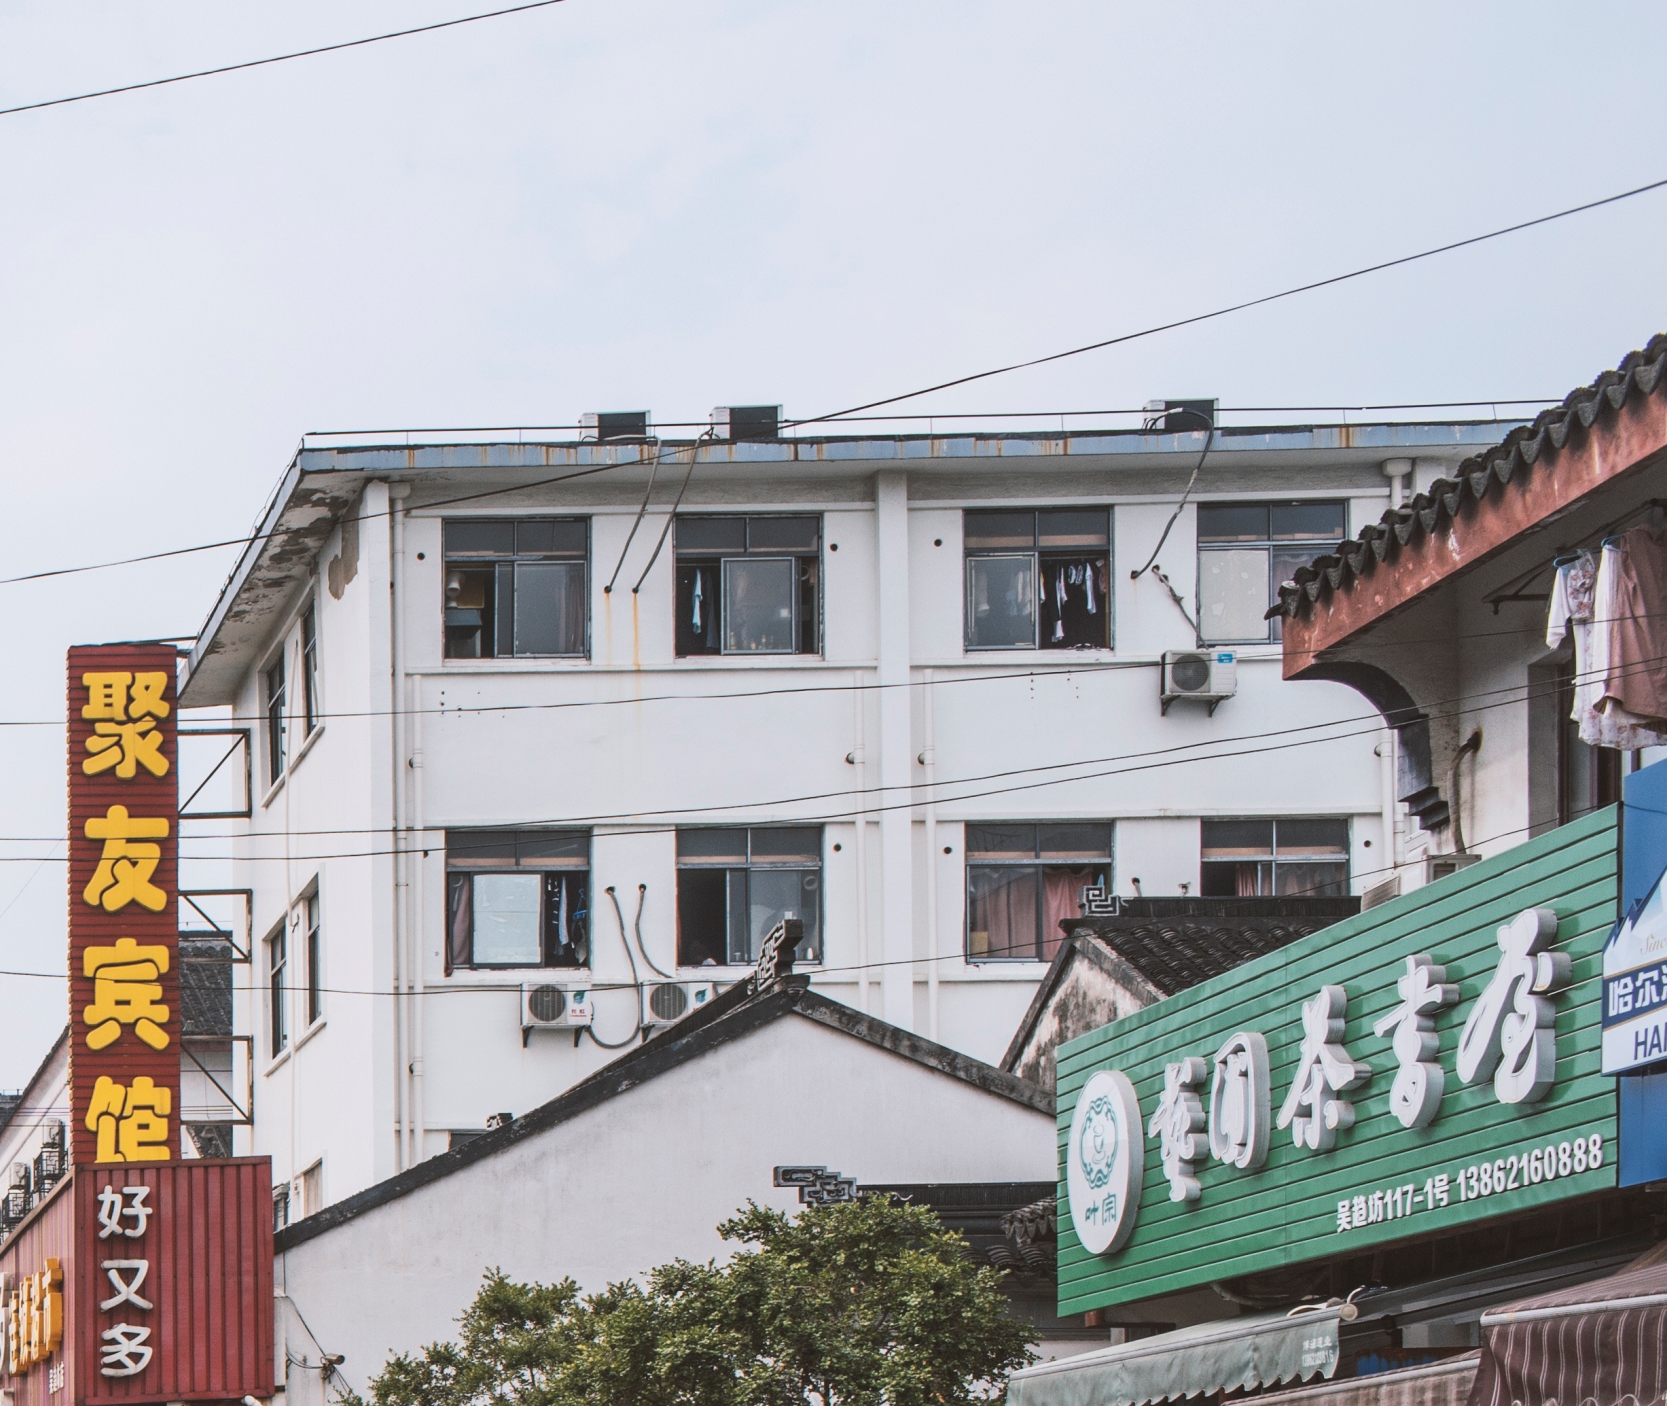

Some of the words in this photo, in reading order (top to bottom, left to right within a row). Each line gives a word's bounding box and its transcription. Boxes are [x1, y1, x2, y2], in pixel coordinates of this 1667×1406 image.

[81, 670, 172, 1164] 聚友宾馆
[1634, 1021, 1667, 1061] HA
[1455, 1133, 1604, 1205] 13862160888
[97, 1184, 154, 1378] 好又多
